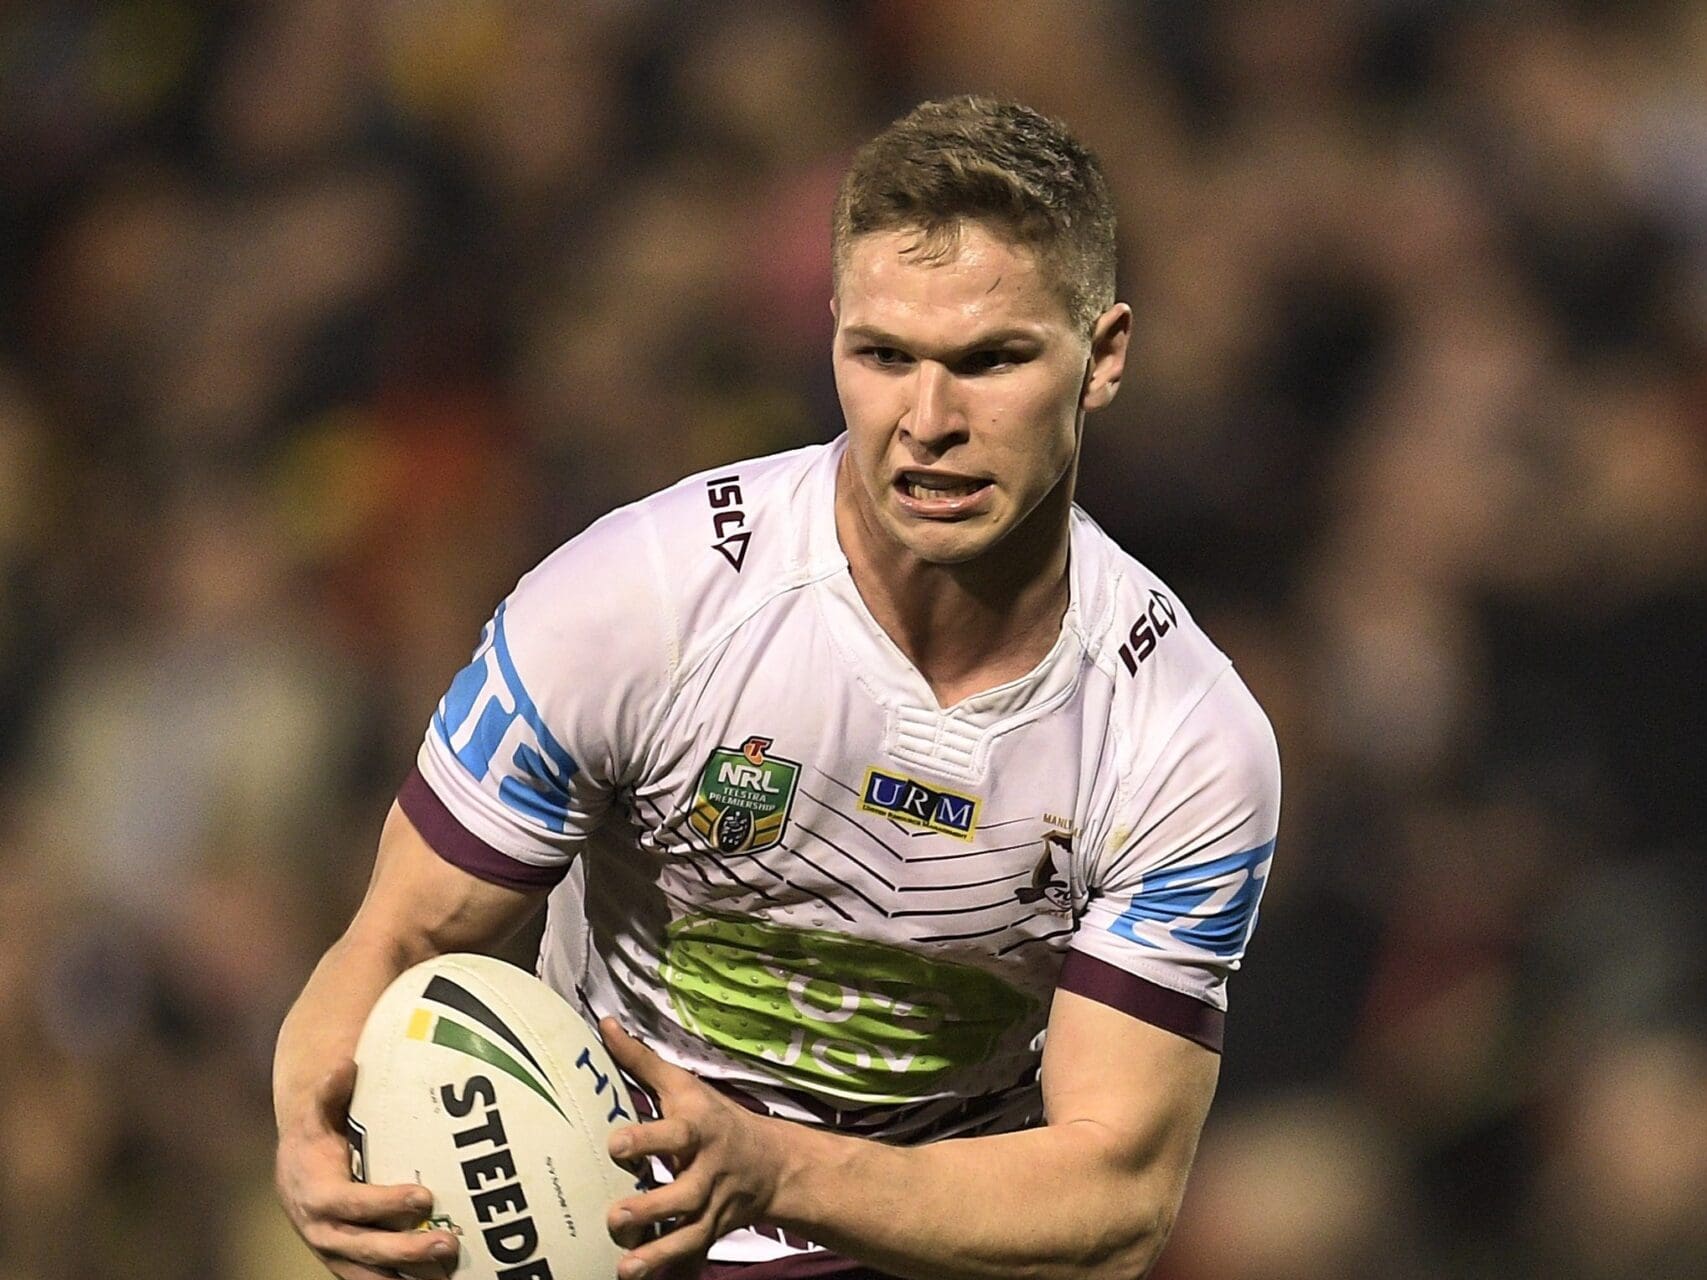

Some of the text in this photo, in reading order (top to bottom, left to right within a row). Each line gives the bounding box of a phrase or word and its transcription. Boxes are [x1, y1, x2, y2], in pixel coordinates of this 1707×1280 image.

[707, 475, 745, 538] ISC
[1118, 598, 1170, 678] ISC
[718, 762, 779, 793] NRL
[724, 787, 767, 802] TELSTRA
[709, 792, 776, 811] PREMIERSHIP
[872, 778, 971, 826] URM
